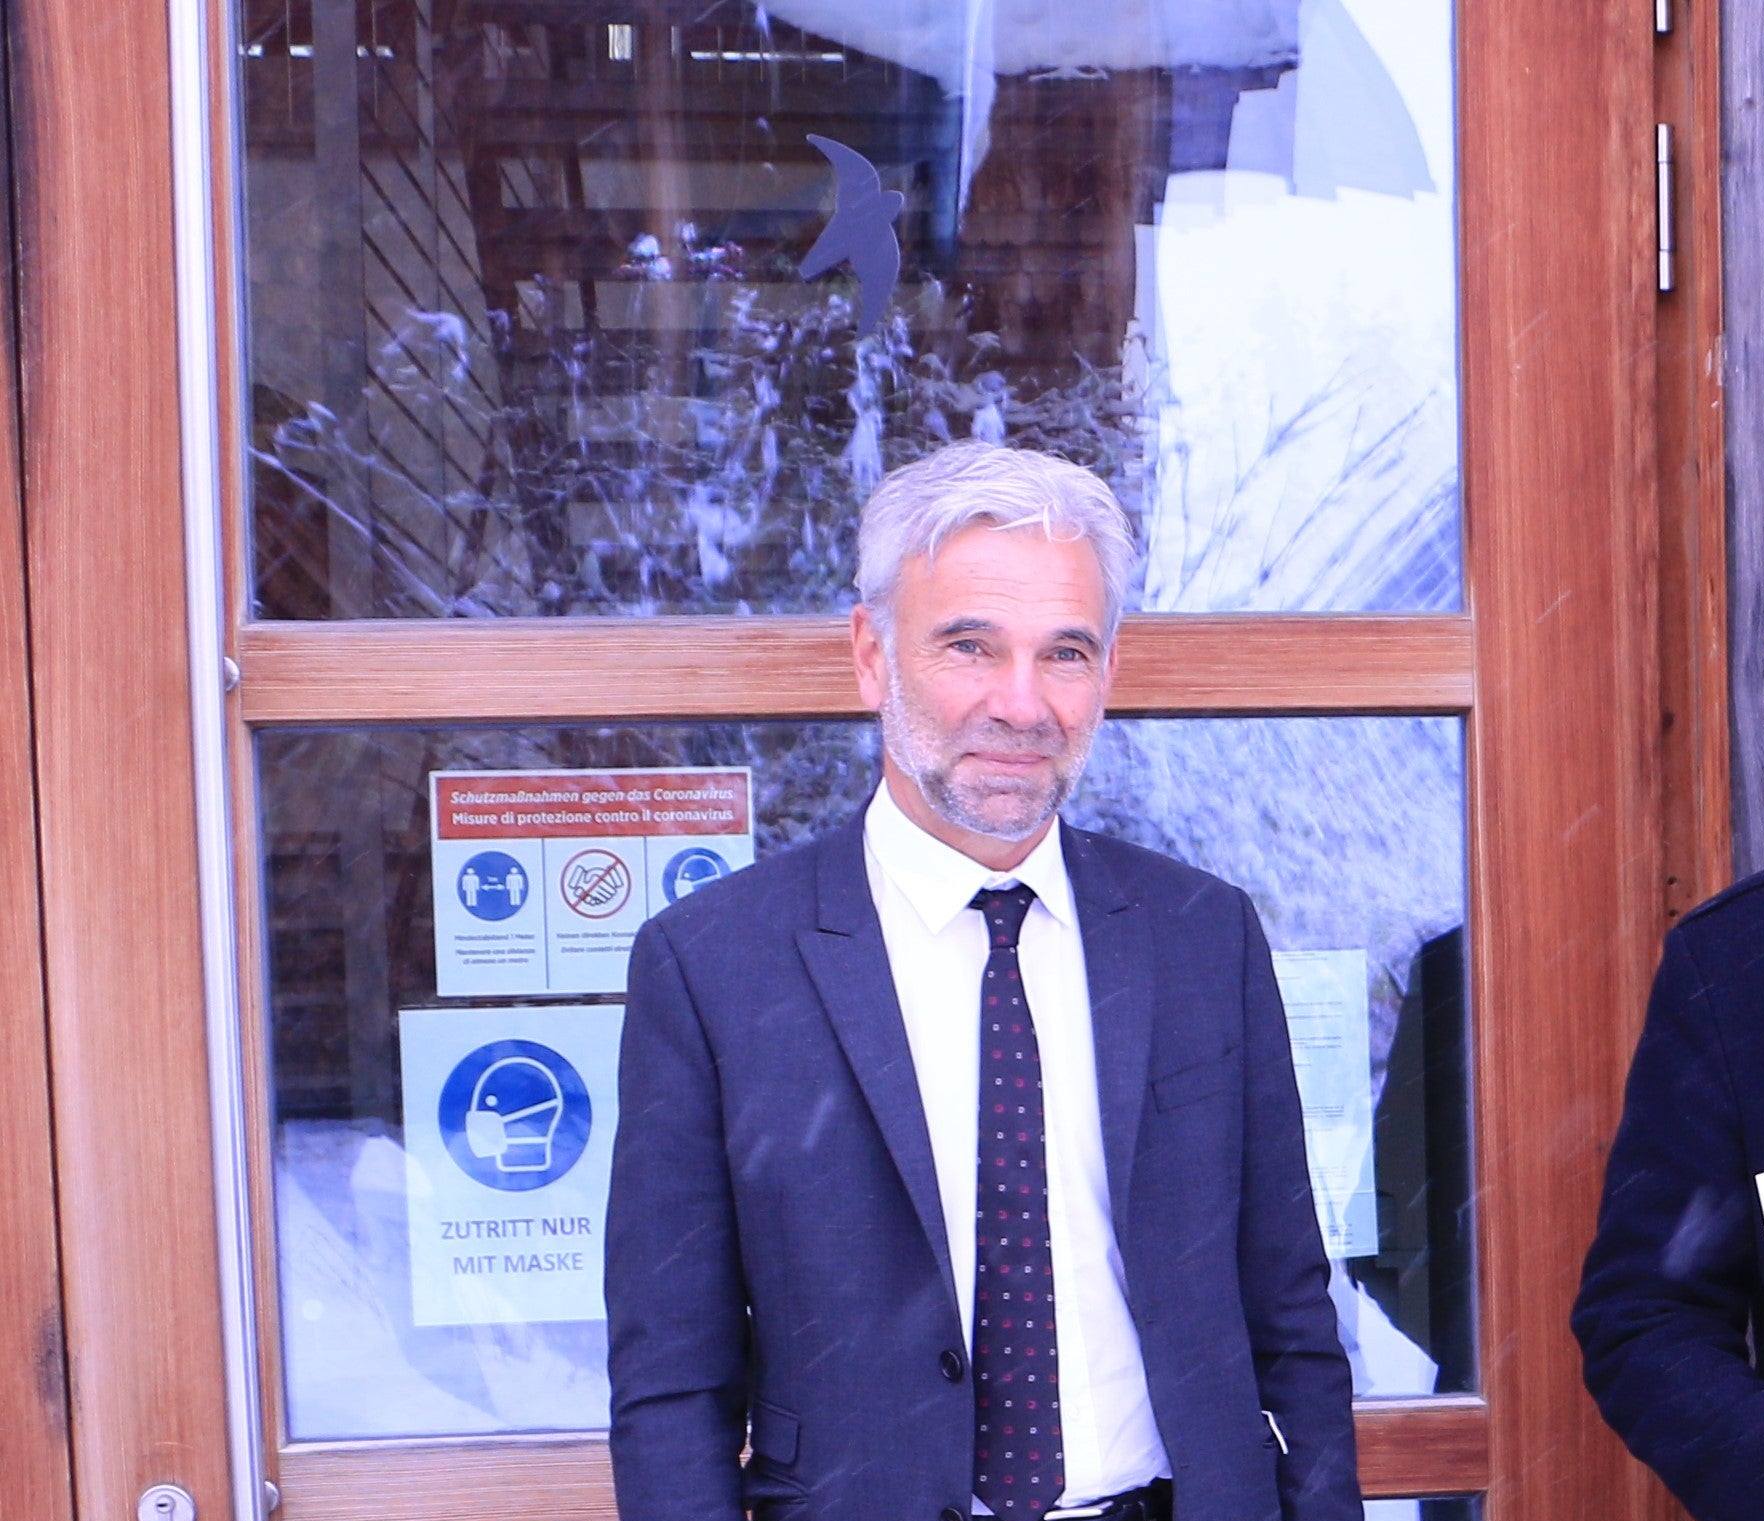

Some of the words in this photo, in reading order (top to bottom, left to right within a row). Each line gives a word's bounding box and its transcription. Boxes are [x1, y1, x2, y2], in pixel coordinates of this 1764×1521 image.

[450, 789, 579, 804] Schutzmaßnahmen
[581, 789, 625, 804] gegen
[626, 788, 651, 801] das
[653, 788, 734, 801] Coronavirus
[452, 812, 498, 825] Misure
[500, 811, 515, 824] di
[517, 810, 592, 826] protezione
[594, 810, 639, 823] contro
[642, 808, 650, 822] il
[653, 808, 734, 822] coronavirus
[440, 1218, 535, 1240] ZUTRITT
[541, 1216, 592, 1236] NUR
[453, 1255, 497, 1275] MIT
[503, 1252, 584, 1273] MASKE
